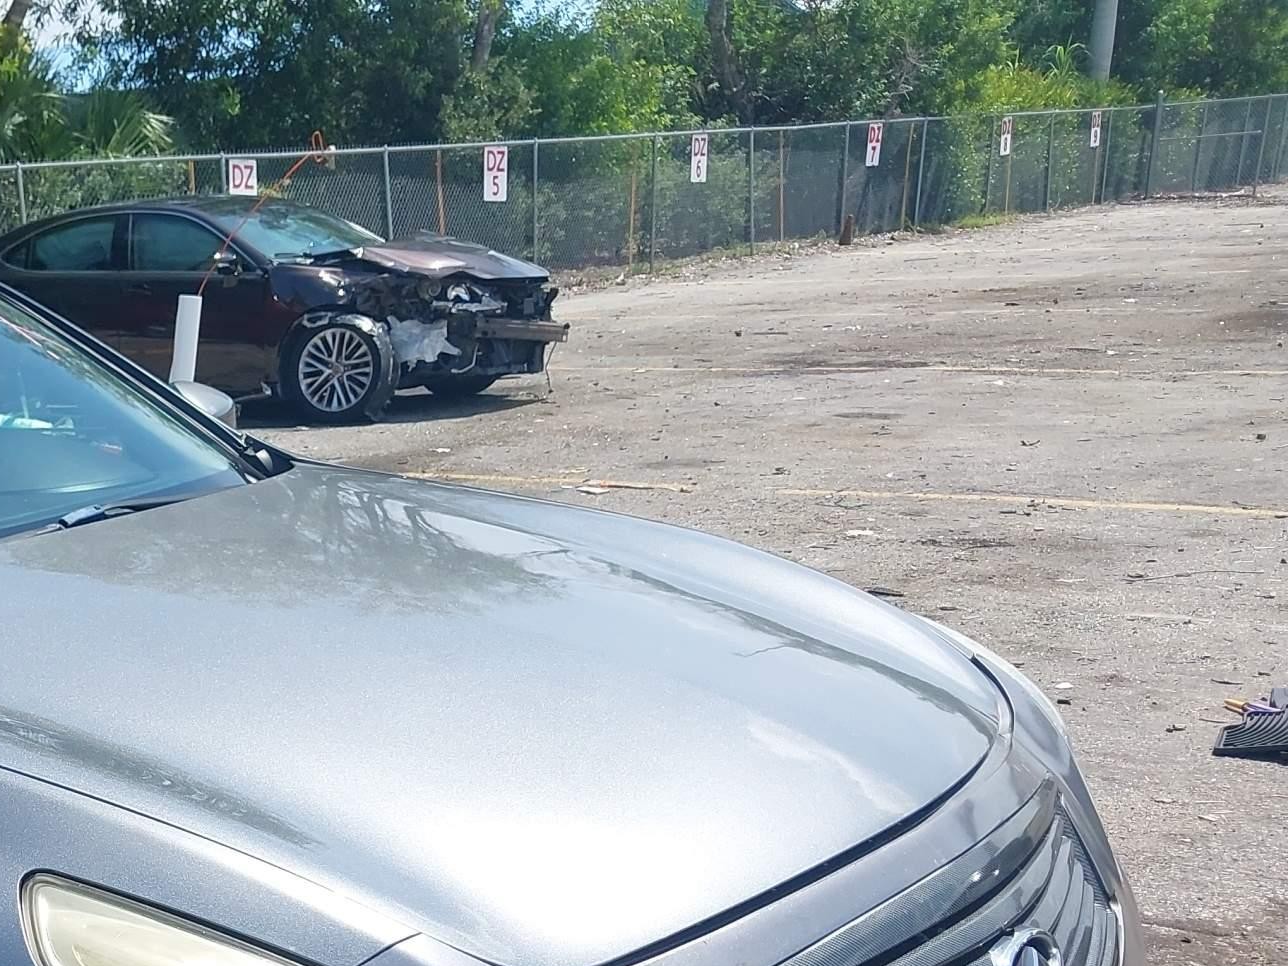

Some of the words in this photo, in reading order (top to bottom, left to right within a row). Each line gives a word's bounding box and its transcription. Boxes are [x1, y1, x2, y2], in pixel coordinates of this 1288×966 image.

[869, 126, 881, 143] DZ
[694, 138, 706, 156] DZ
[871, 146, 877, 162] 7
[487, 150, 506, 172] DZ
[696, 160, 702, 178] 6
[232, 165, 254, 189] DZ
[493, 175, 499, 196] 5
